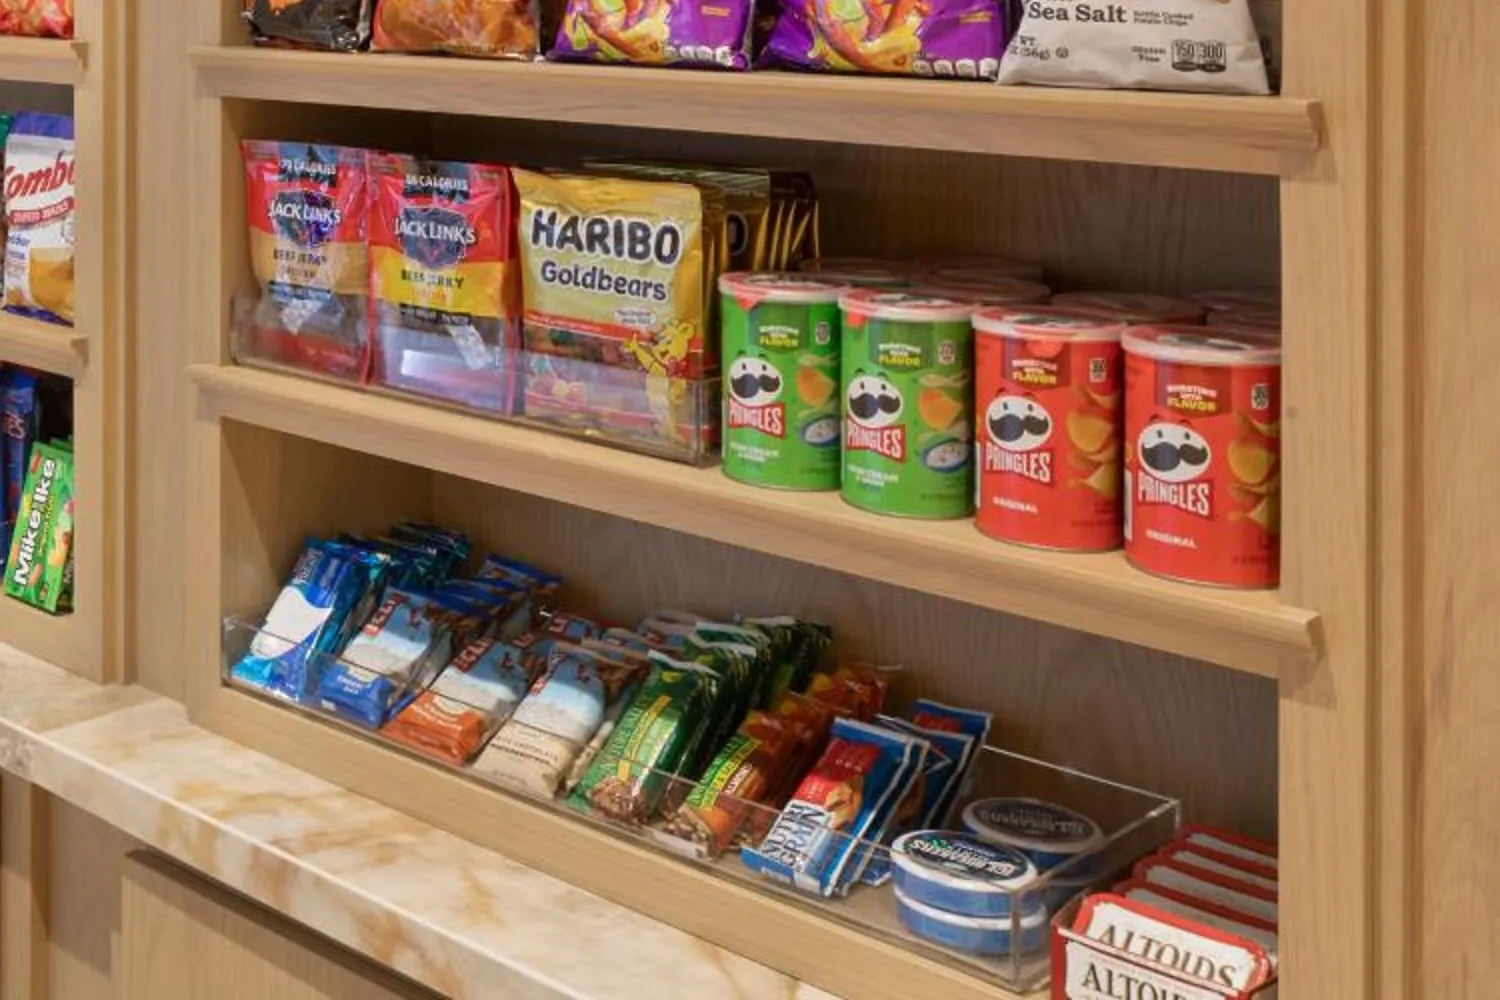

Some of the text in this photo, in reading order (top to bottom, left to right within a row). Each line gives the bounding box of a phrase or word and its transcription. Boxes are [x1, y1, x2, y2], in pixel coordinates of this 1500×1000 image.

[1028, 2, 1128, 23] Sea Salt
[269, 199, 301, 218] JACK
[394, 217, 428, 239] JACK
[531, 207, 681, 267] HARIBO
[541, 260, 667, 302] Goldbears
[759, 336, 799, 348] FLAVOR
[878, 355, 921, 367] FLAVOR
[1012, 371, 1058, 385] FLAVOR
[728, 398, 783, 436] PRINGLES
[1166, 397, 1217, 412] FLAVOR
[847, 419, 903, 461] PRINGLES
[985, 443, 1051, 483] PRINGLES
[1138, 470, 1210, 517] PRINGLES
[13, 458, 56, 587] Mike Ike
[1100, 925, 1238, 987] ALTOIDS
[1082, 962, 1190, 1000] ALTOI
